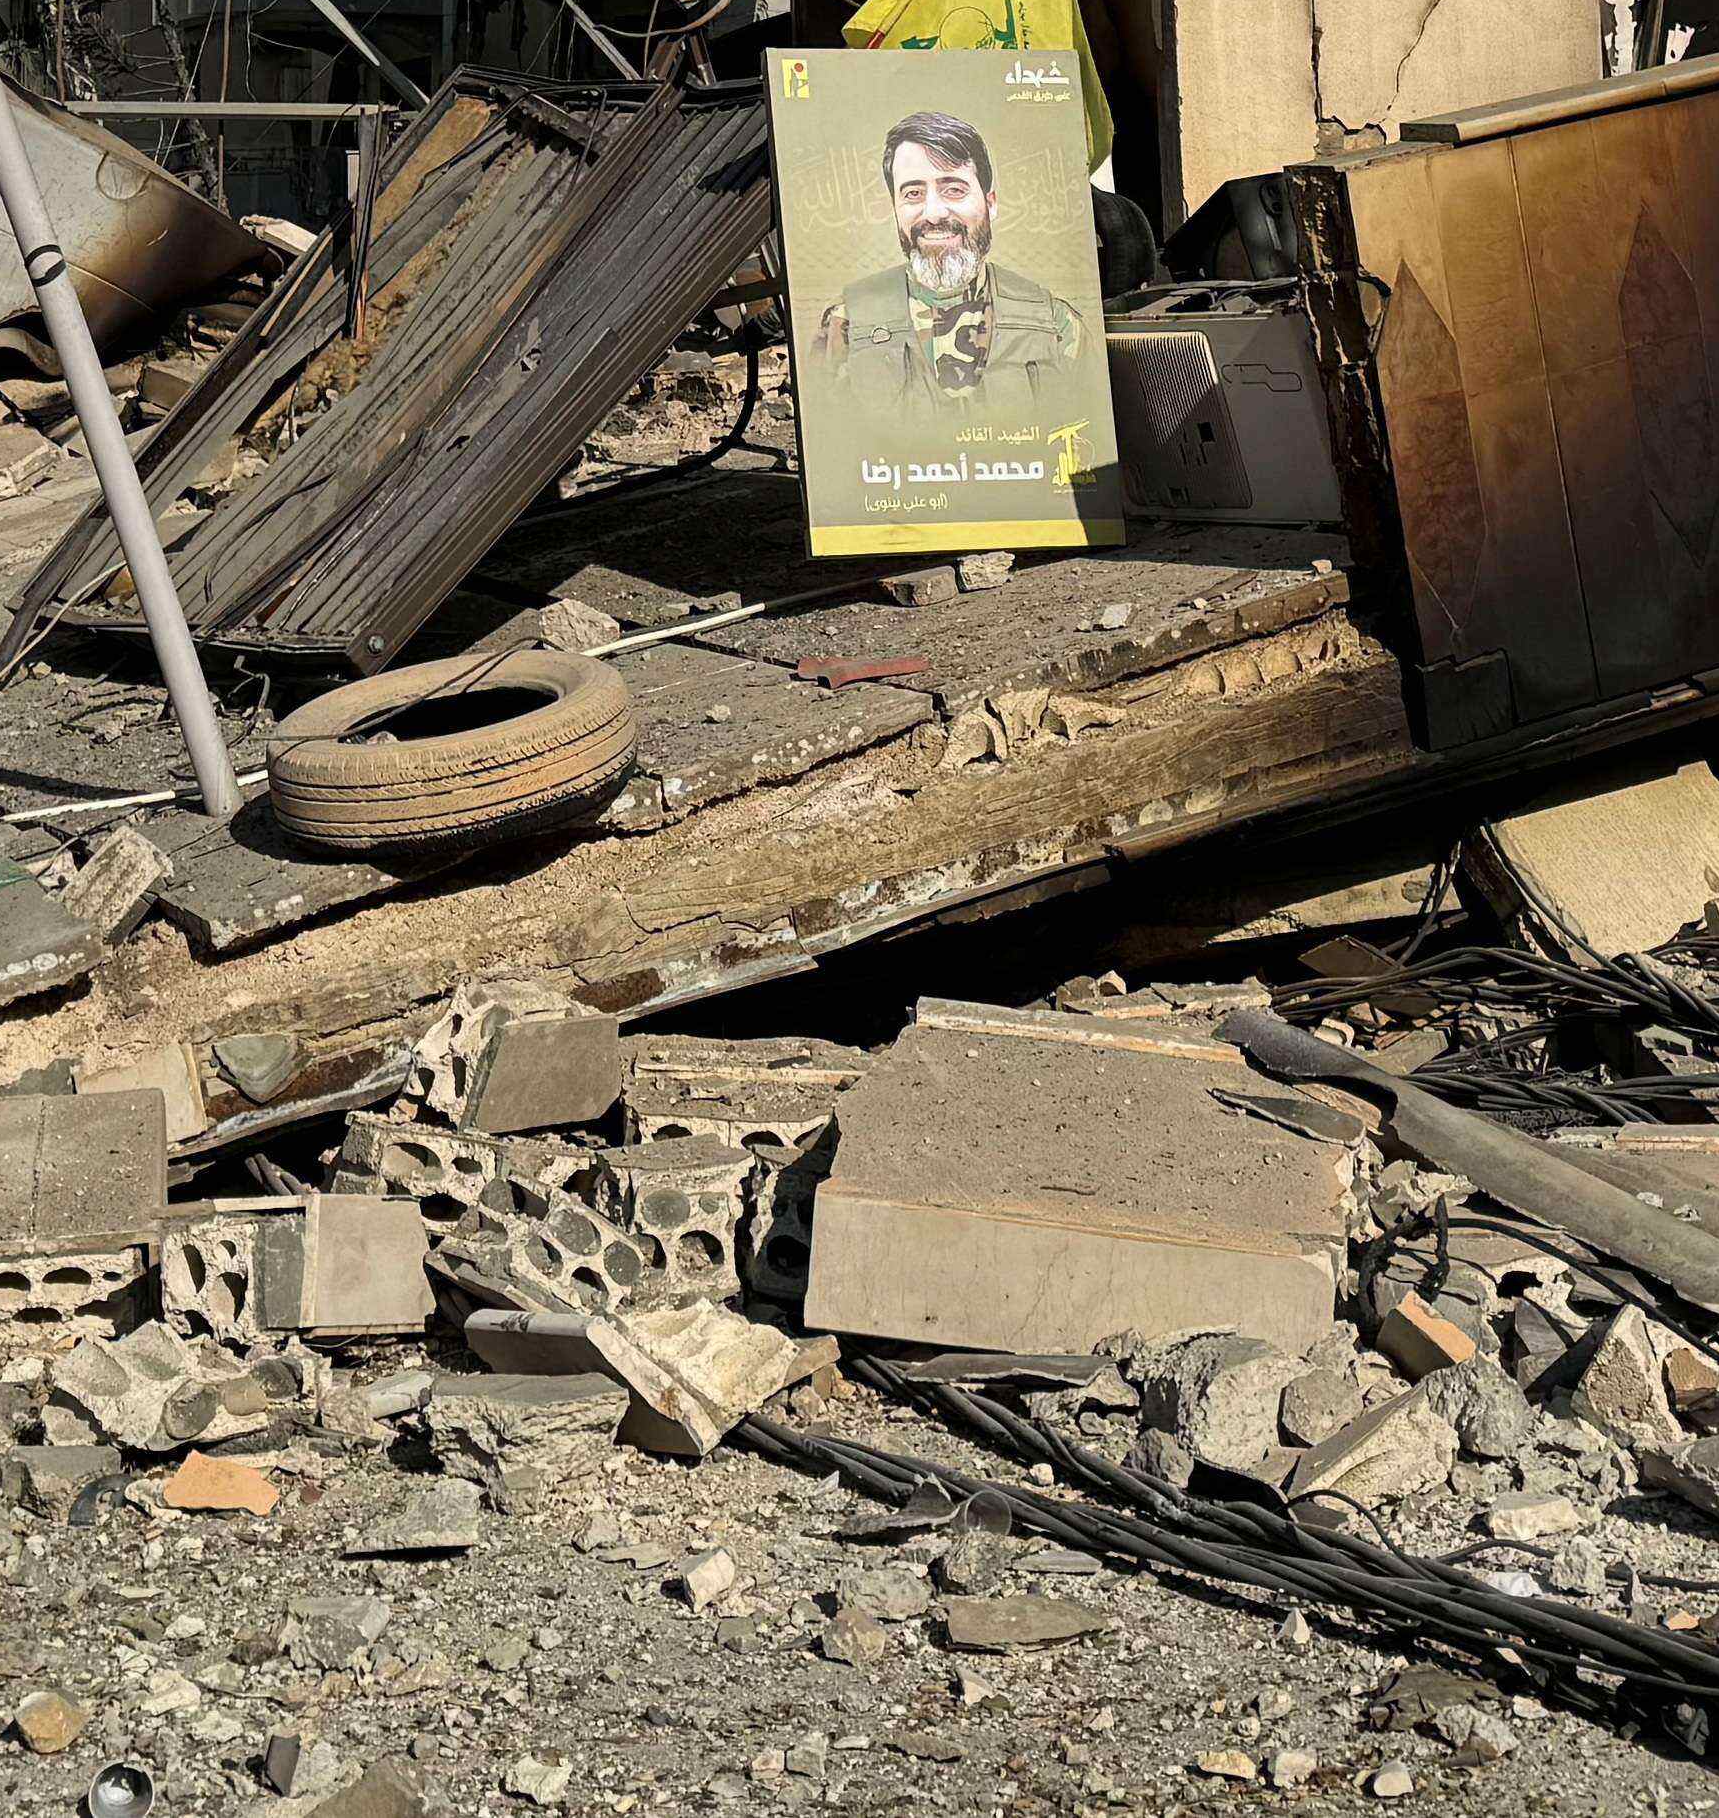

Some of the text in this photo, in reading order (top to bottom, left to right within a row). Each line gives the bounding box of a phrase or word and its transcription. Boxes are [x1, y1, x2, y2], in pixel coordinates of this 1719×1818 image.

[1005, 60, 1070, 88] شهداء
[955, 425, 1040, 445] الشهيد القائد
[862, 457, 901, 490] رضا
[907, 452, 969, 482] أحمد
[974, 461, 1044, 481] محمد
